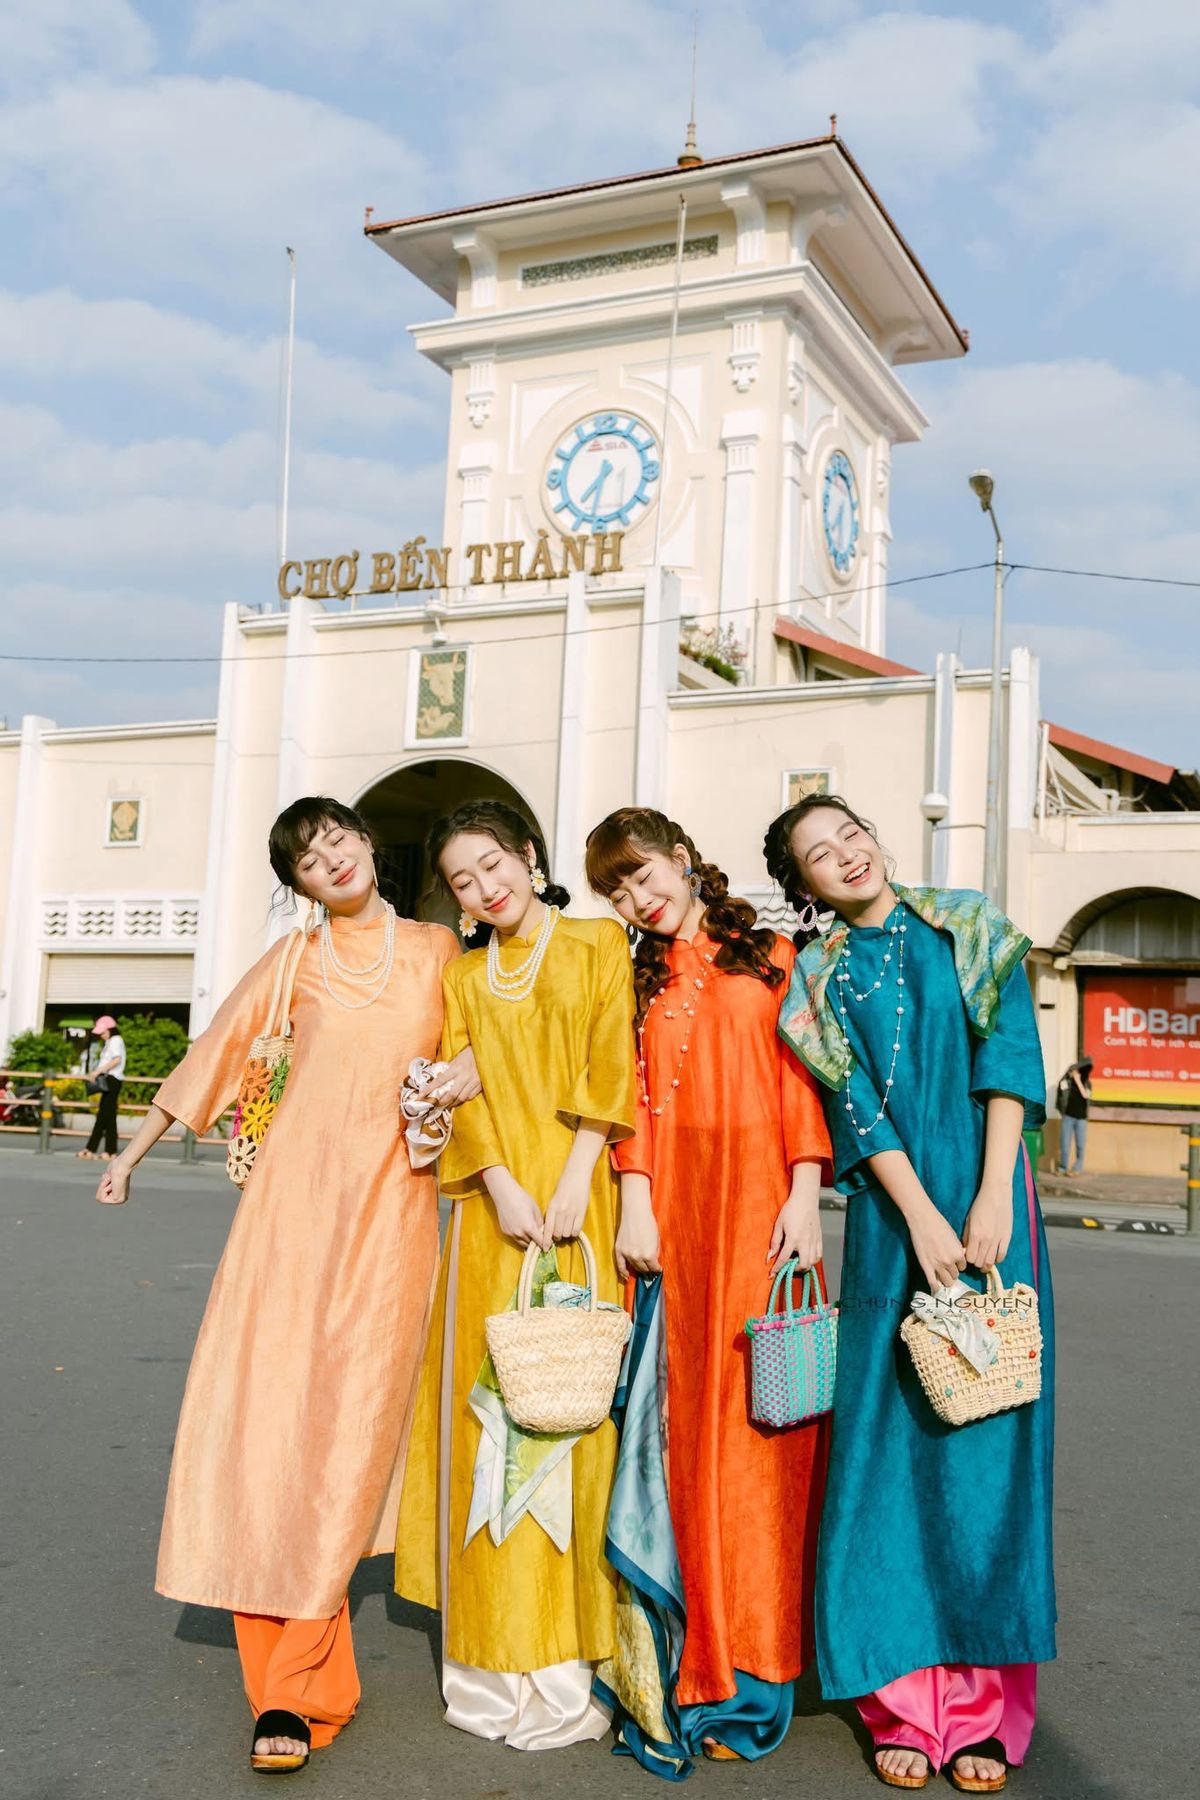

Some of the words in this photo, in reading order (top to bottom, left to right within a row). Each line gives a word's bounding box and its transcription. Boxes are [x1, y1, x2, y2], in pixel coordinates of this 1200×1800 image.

[278, 550, 359, 600] CHỢ
[369, 536, 452, 593] BẾN
[467, 529, 625, 585] THÀNH
